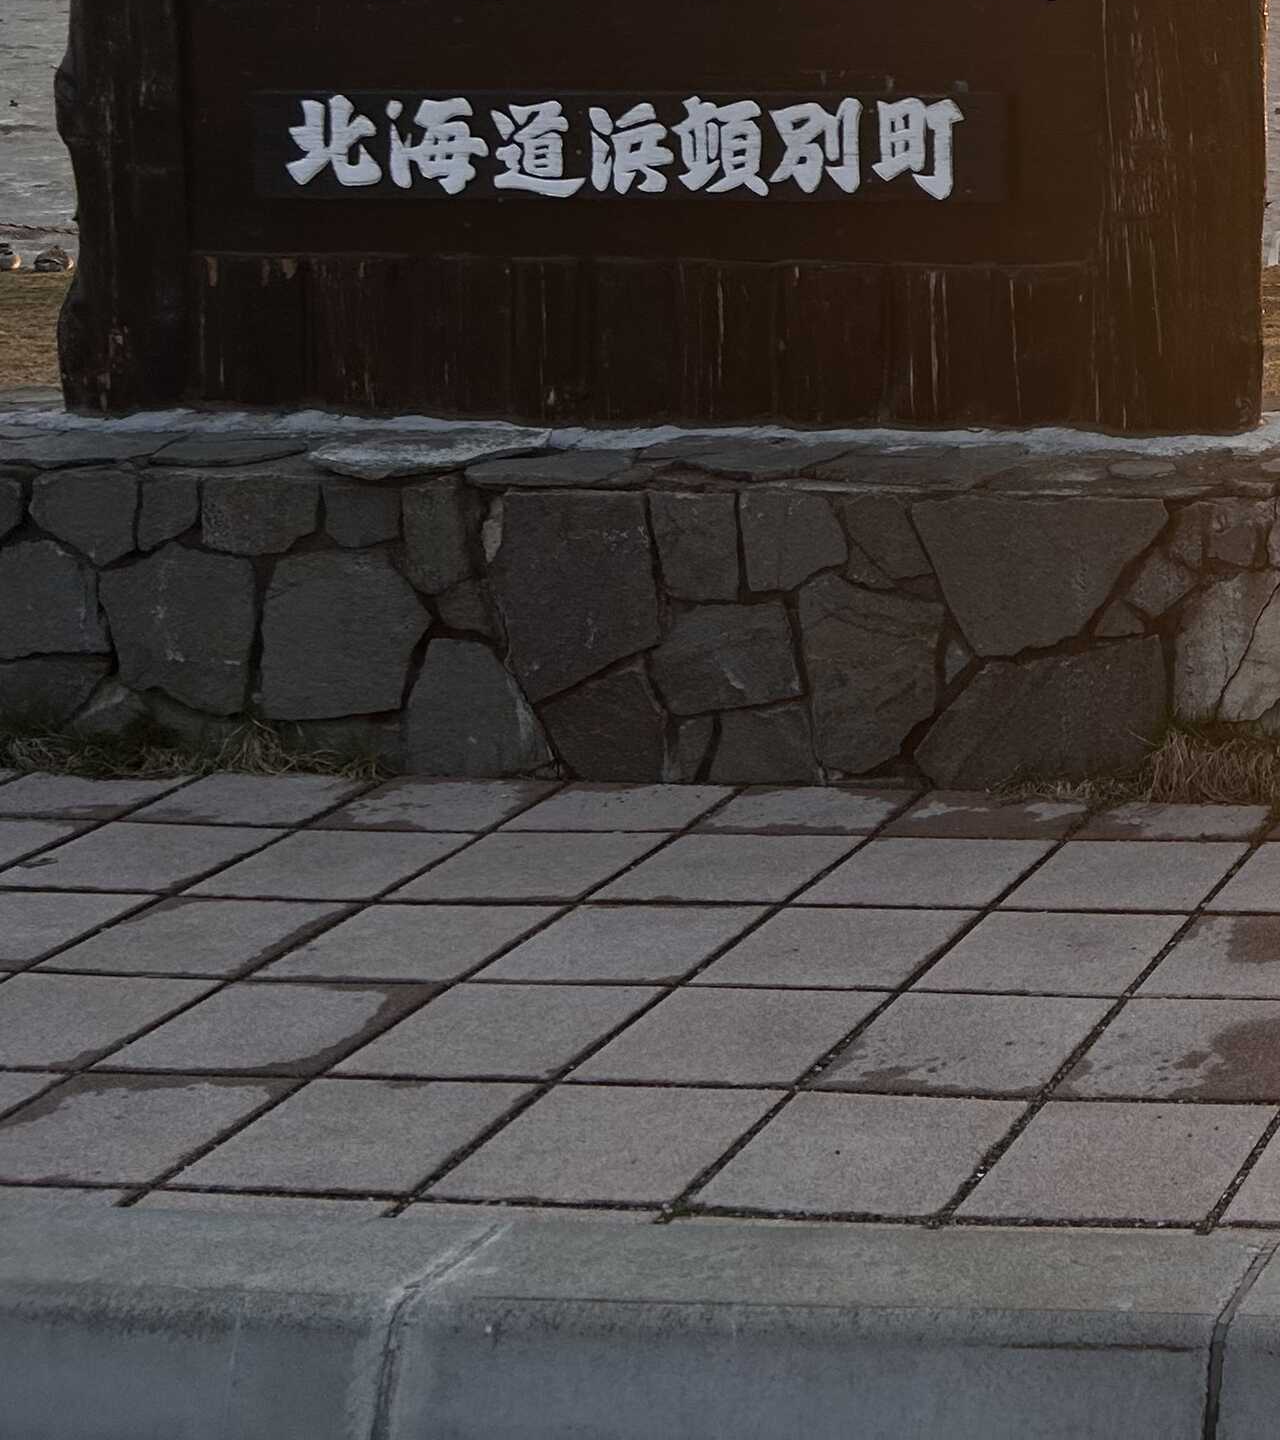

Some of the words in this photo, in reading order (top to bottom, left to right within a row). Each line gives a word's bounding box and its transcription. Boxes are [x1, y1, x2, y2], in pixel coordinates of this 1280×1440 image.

[287, 95, 963, 199] 北海道浜頓別町
